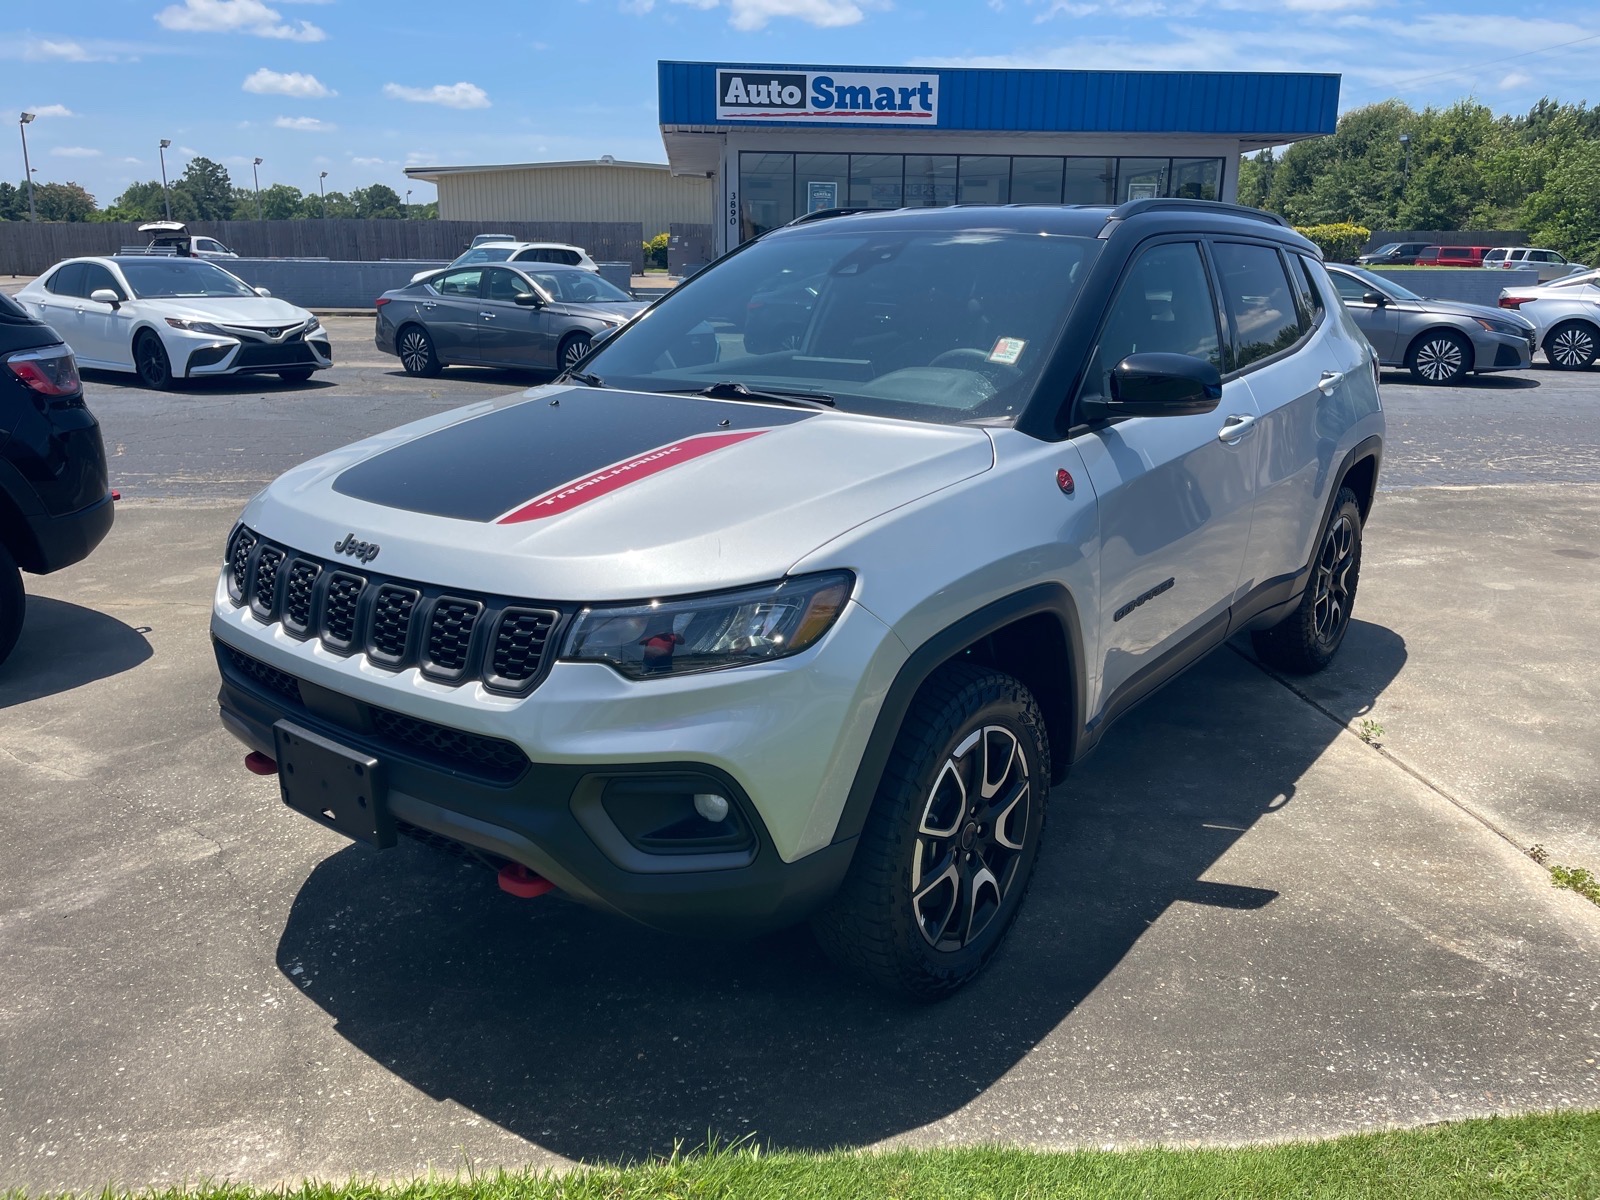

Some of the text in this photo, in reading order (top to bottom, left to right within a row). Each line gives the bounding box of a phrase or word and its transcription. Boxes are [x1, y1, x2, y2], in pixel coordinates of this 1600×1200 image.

[724, 75, 933, 112] Auto Smart
[729, 191, 737, 226] 3890
[535, 446, 682, 507] TRAILHAWK
[334, 532, 380, 565] Jeep
